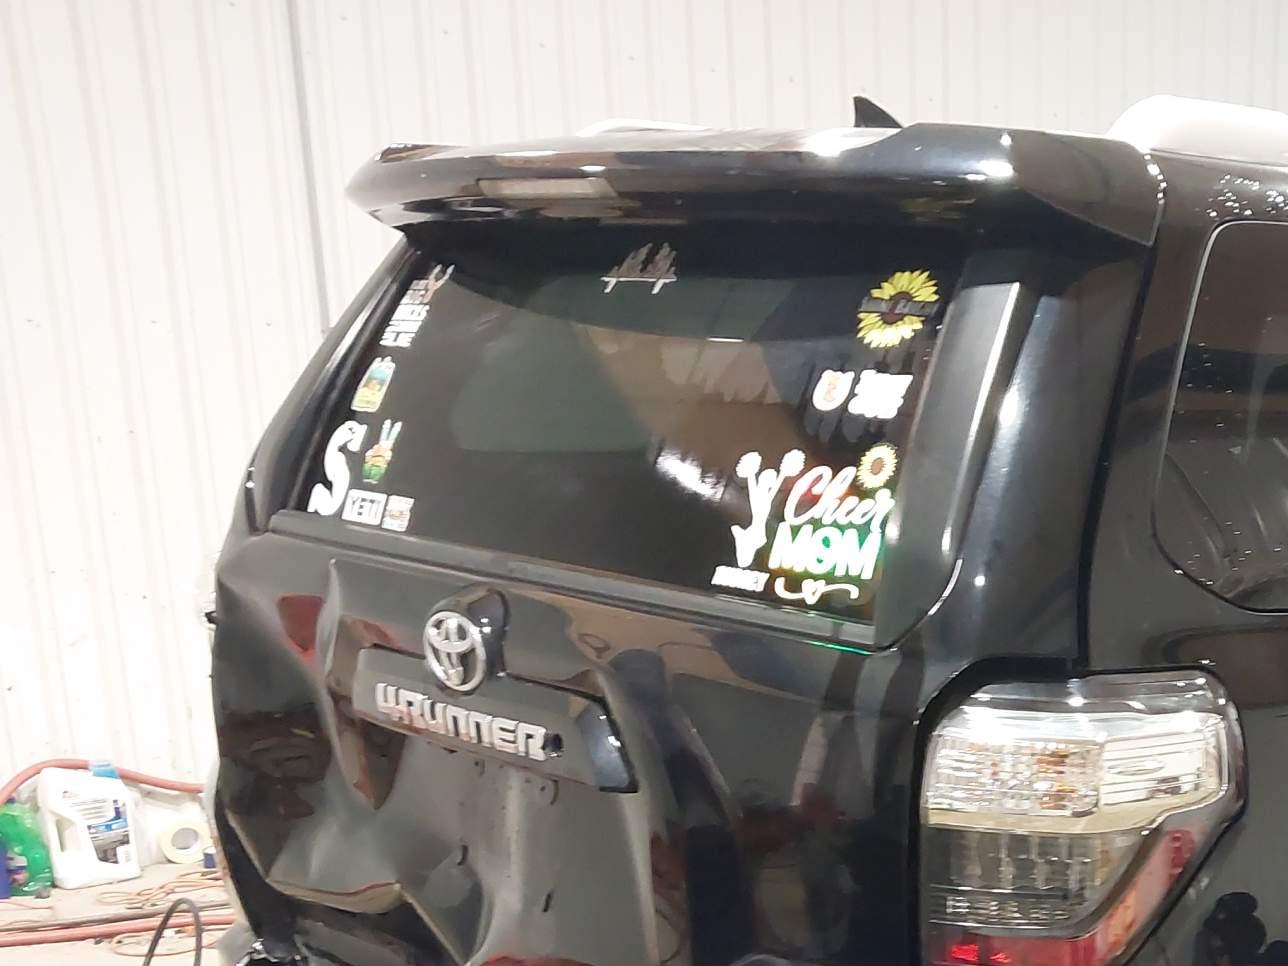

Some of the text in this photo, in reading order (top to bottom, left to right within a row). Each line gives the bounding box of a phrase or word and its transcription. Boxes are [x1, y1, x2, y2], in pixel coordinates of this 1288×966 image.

[348, 495, 383, 521] YETI
[784, 465, 896, 533] Cheer
[768, 521, 882, 580] MOM
[375, 682, 547, 761] 4RUNNER
